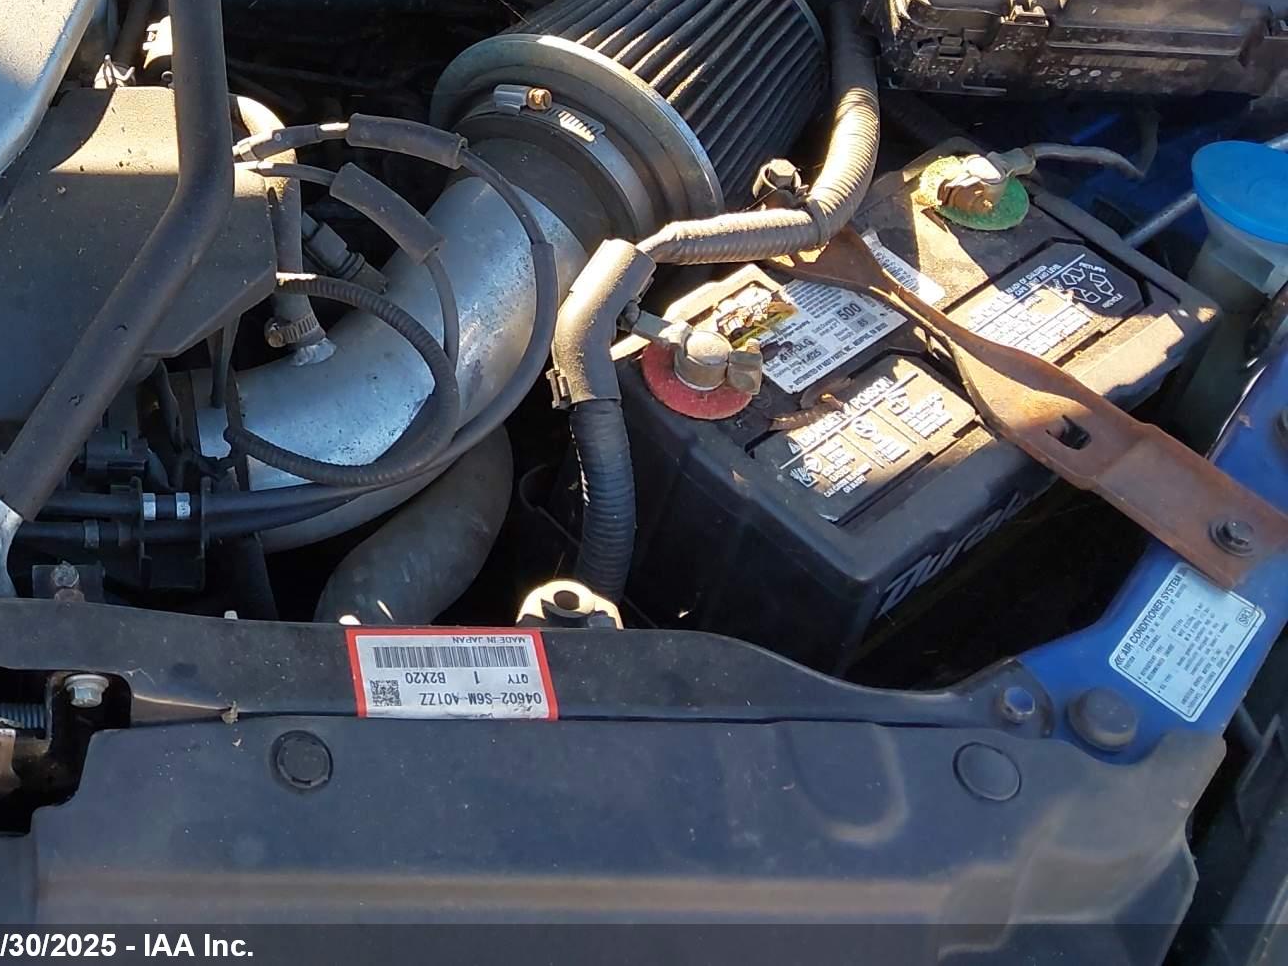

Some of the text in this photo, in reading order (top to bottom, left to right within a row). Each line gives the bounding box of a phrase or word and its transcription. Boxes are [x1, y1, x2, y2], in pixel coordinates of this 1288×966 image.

[837, 302, 862, 321] 500
[1123, 642, 1135, 657] AIR
[1129, 599, 1166, 644] CONDITIONER
[1160, 575, 1184, 601] SYSTEM
[405, 671, 529, 683] QTY 1 B2X20
